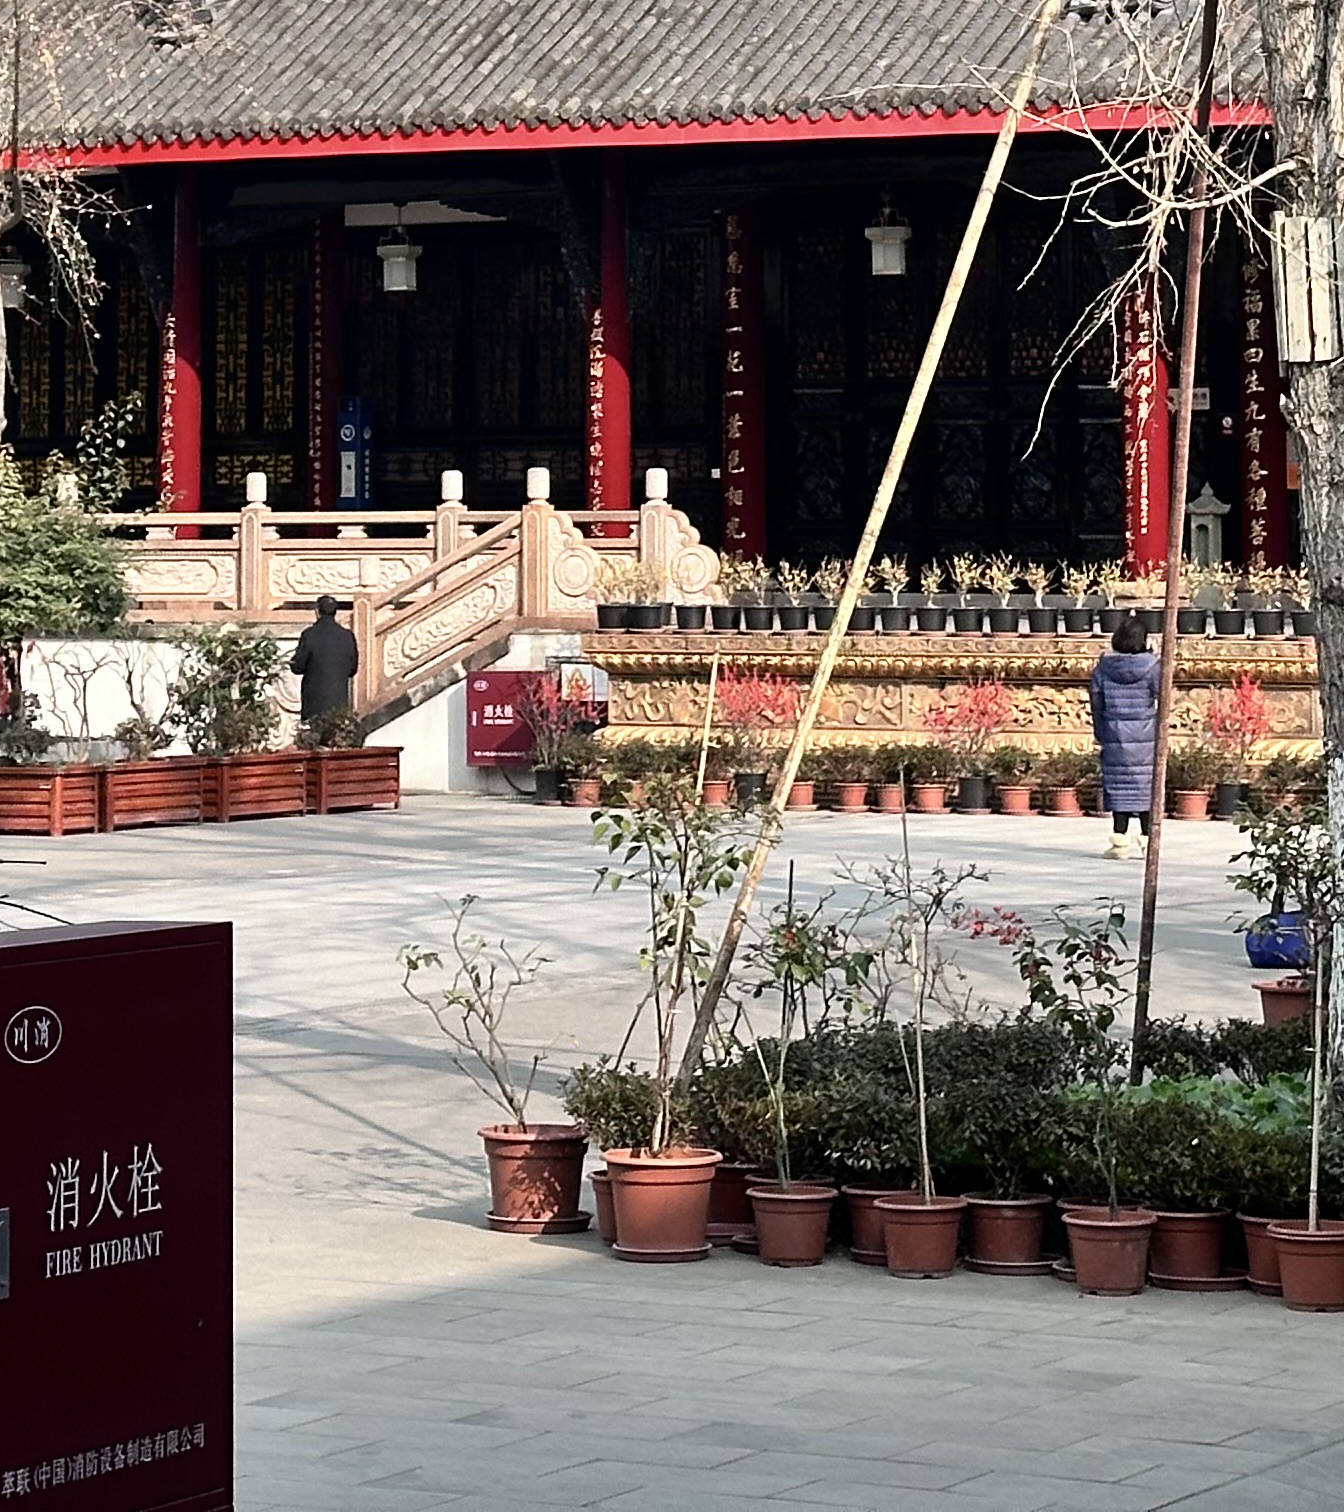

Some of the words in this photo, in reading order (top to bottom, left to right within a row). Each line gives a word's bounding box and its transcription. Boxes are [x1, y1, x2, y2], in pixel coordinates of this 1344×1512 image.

[14, 1016, 51, 1053] 川消
[46, 1142, 163, 1232] 消火栓
[45, 1246, 83, 1279] FIRE
[89, 1230, 164, 1270] HYDRANT
